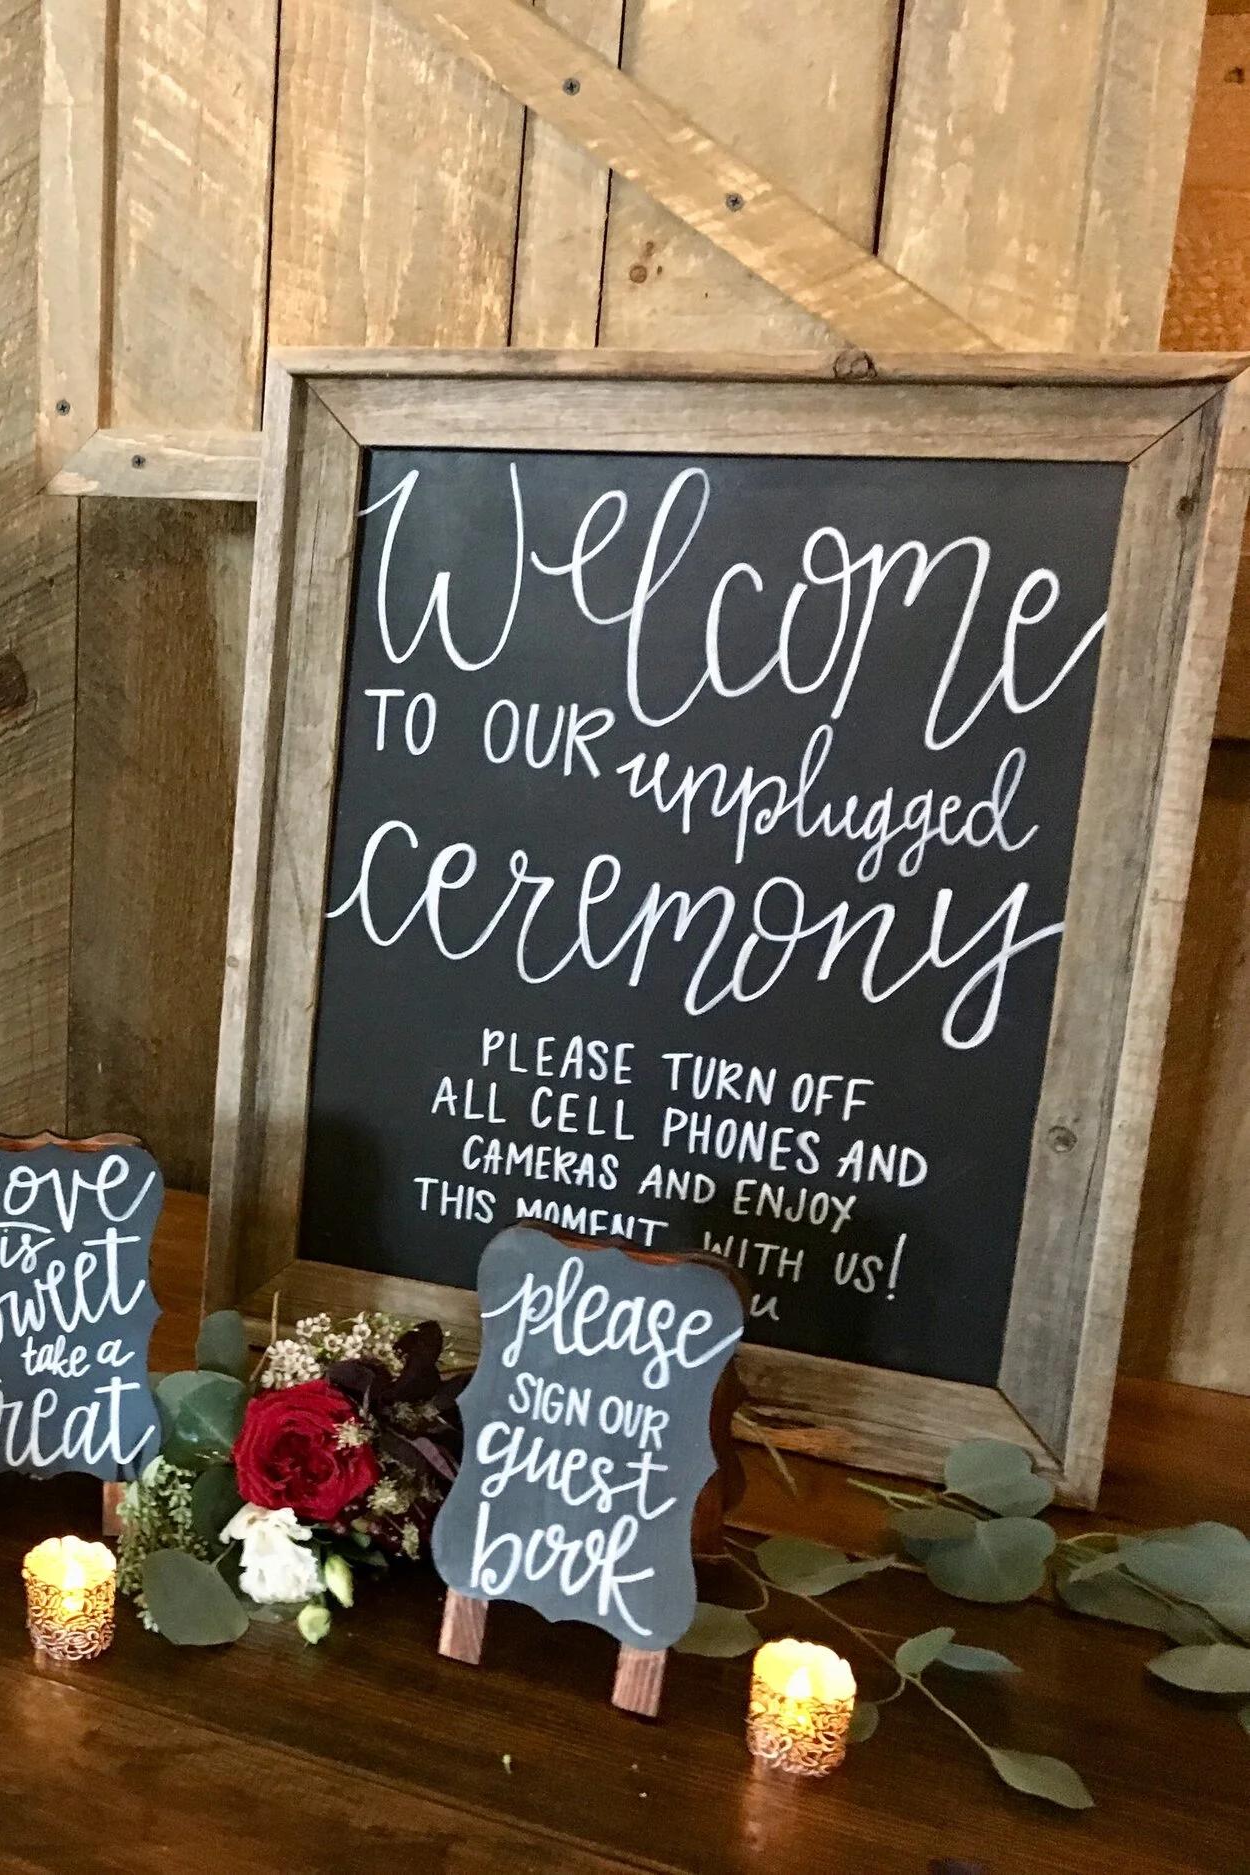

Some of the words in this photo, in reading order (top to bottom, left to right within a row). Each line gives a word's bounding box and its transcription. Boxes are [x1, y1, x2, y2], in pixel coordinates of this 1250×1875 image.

[356, 463, 1108, 750] Welcome
[364, 689, 437, 755] TO
[484, 699, 615, 779] OUR
[617, 725, 1039, 883] unplugged
[483, 1028, 635, 1085] PLEASE
[661, 1053, 775, 1106] TURN
[791, 1073, 874, 1121] OFF
[431, 1076, 506, 1125] ALL
[531, 1086, 635, 1141] CELL
[662, 1107, 821, 1175] PHONES
[836, 1140, 928, 1188] AND
[462, 1134, 619, 1190] CAMERAS
[638, 1164, 716, 1204] AND
[733, 1179, 858, 1234] ENJOY
[0, 1228, 55, 1274] is
[413, 1177, 497, 1224] THIS
[702, 1230, 803, 1283] WITH
[835, 1232, 908, 1300] US!
[20, 1335, 91, 1378] take
[97, 1338, 136, 1367] a
[480, 1256, 744, 1389] please
[508, 1372, 591, 1427] SIGN
[599, 1395, 670, 1451] OUR
[476, 1420, 677, 1520] guest
[469, 1501, 655, 1636] book
